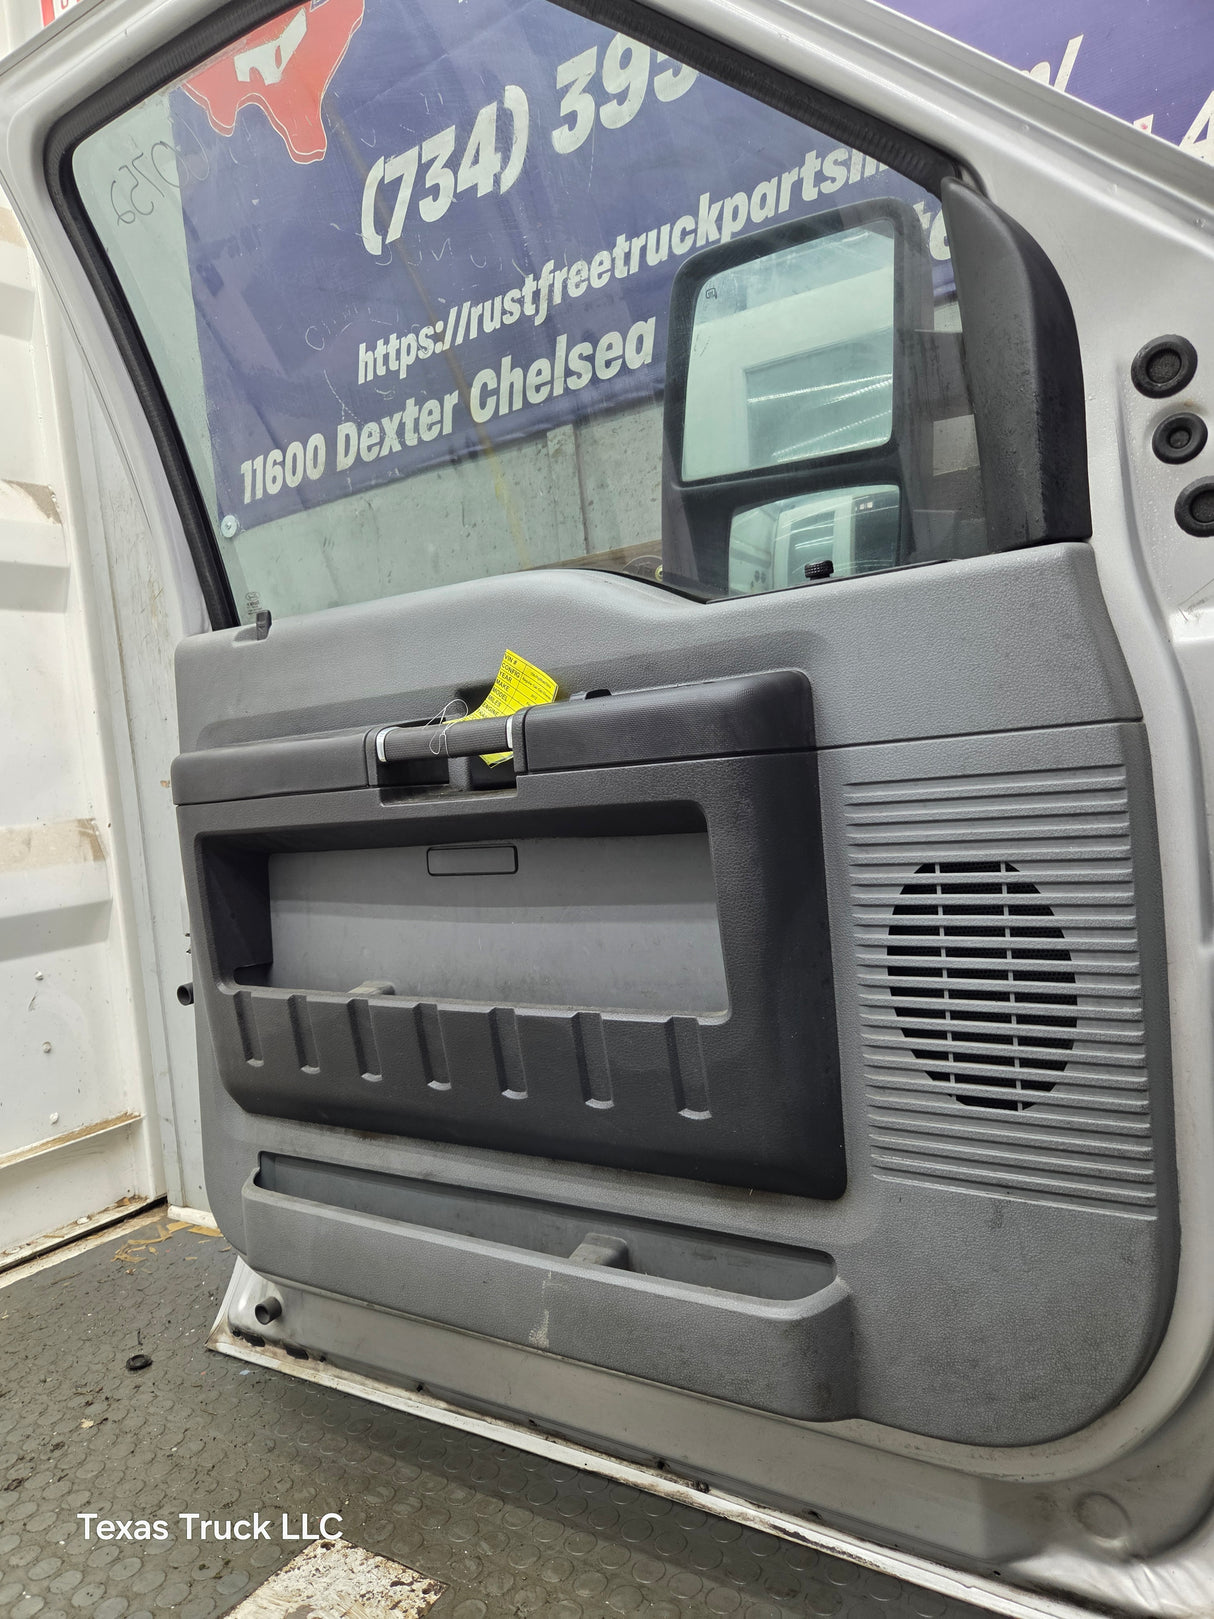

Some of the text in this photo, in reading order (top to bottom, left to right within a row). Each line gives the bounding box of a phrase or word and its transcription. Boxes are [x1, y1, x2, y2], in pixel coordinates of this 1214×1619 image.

[361, 84, 530, 256] (734)
[240, 433, 326, 505] 11600
[336, 389, 459, 472] Dexter
[470, 316, 656, 424] Chelsea
[499, 671, 513, 684] YEAR
[501, 662, 520, 678] CONFIG
[496, 678, 510, 692] MAKE
[492, 686, 508, 701] MODEL
